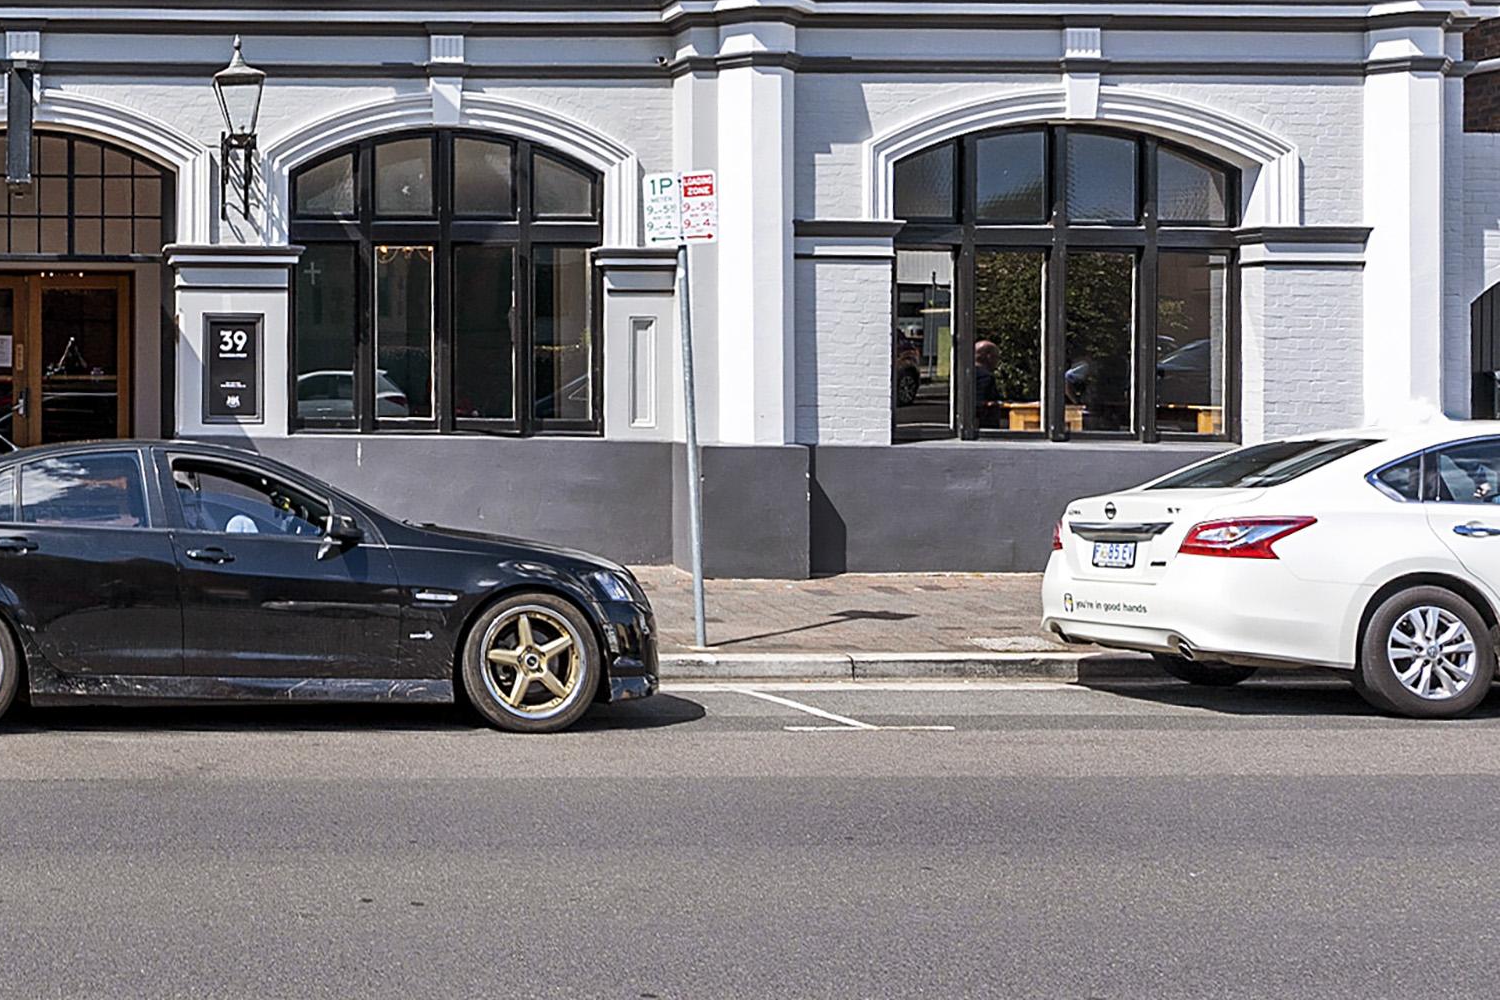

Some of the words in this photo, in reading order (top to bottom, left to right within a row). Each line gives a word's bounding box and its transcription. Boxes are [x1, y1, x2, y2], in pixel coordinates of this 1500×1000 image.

[650, 177, 673, 195] 1P
[219, 330, 248, 352] 39
[1075, 600, 1094, 610] you're
[1095, 600, 1102, 610] in
[1103, 602, 1121, 612] good
[1122, 602, 1148, 614] hands
